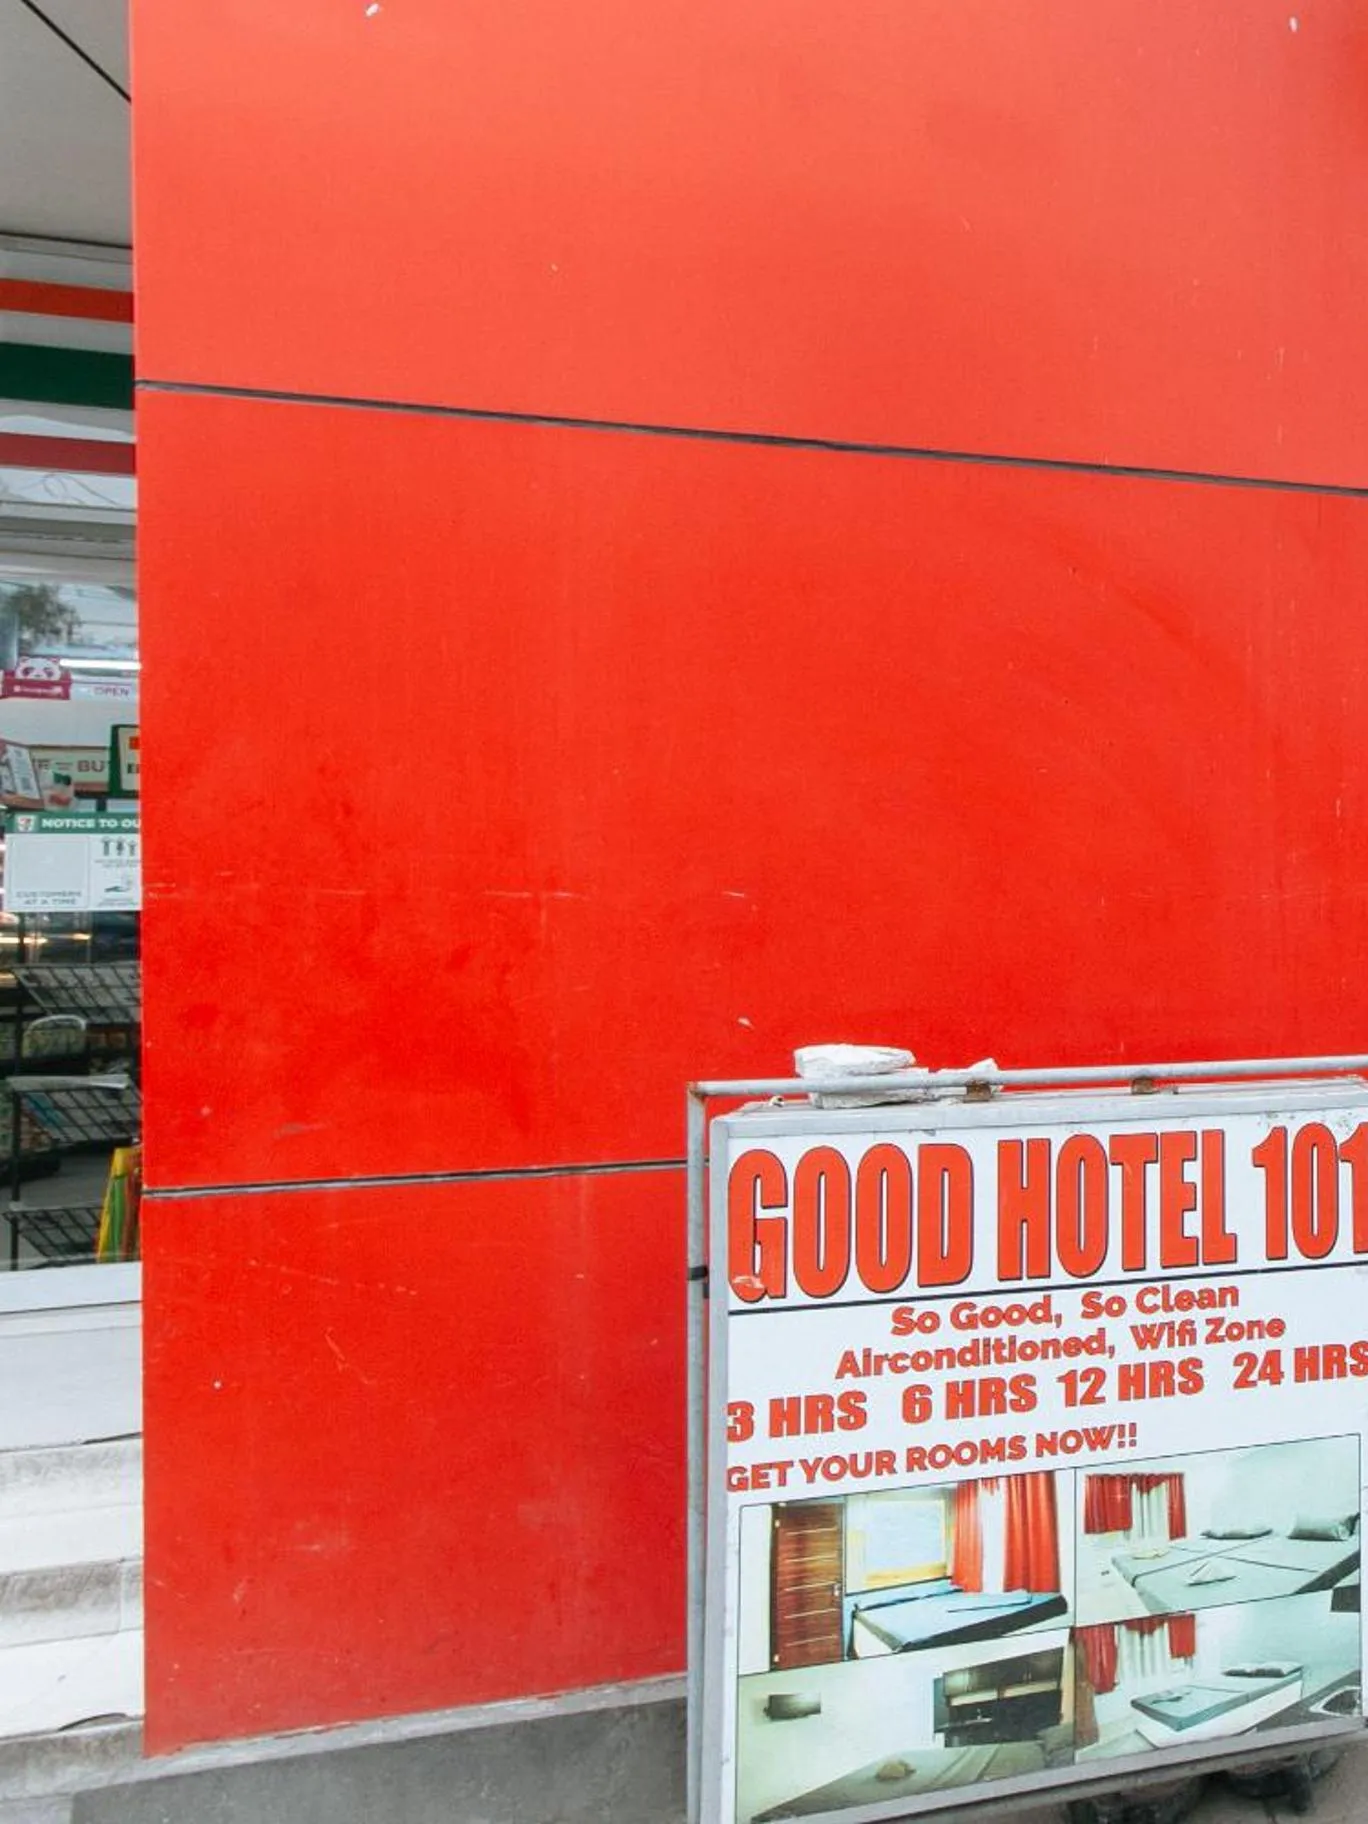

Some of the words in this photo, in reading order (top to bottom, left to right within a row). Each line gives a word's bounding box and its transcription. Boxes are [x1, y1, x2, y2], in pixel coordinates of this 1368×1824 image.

[41, 818, 95, 829] NOTICE
[98, 818, 118, 829] TO
[727, 1141, 974, 1304] GOOD
[997, 1129, 1238, 1280] HOTEL
[891, 1305, 940, 1336] So
[950, 1294, 1062, 1331] Good,
[1080, 1290, 1128, 1319] So
[1135, 1284, 1239, 1315] Clean
[835, 1327, 1115, 1380] Airconditioned,
[1130, 1319, 1197, 1351] Wifi
[1205, 1317, 1286, 1345] Zone
[726, 1401, 755, 1443] 3
[769, 1389, 868, 1438] HRS
[902, 1384, 934, 1424] 6
[945, 1373, 1038, 1420] HRS
[1056, 1366, 1107, 1408] 12
[1117, 1357, 1205, 1402] HRS
[1232, 1349, 1285, 1391] 24
[726, 1460, 794, 1493] GET
[799, 1449, 898, 1485] YOUR
[905, 1435, 1028, 1473] ROOMS
[1035, 1422, 1138, 1458] NOW!!
